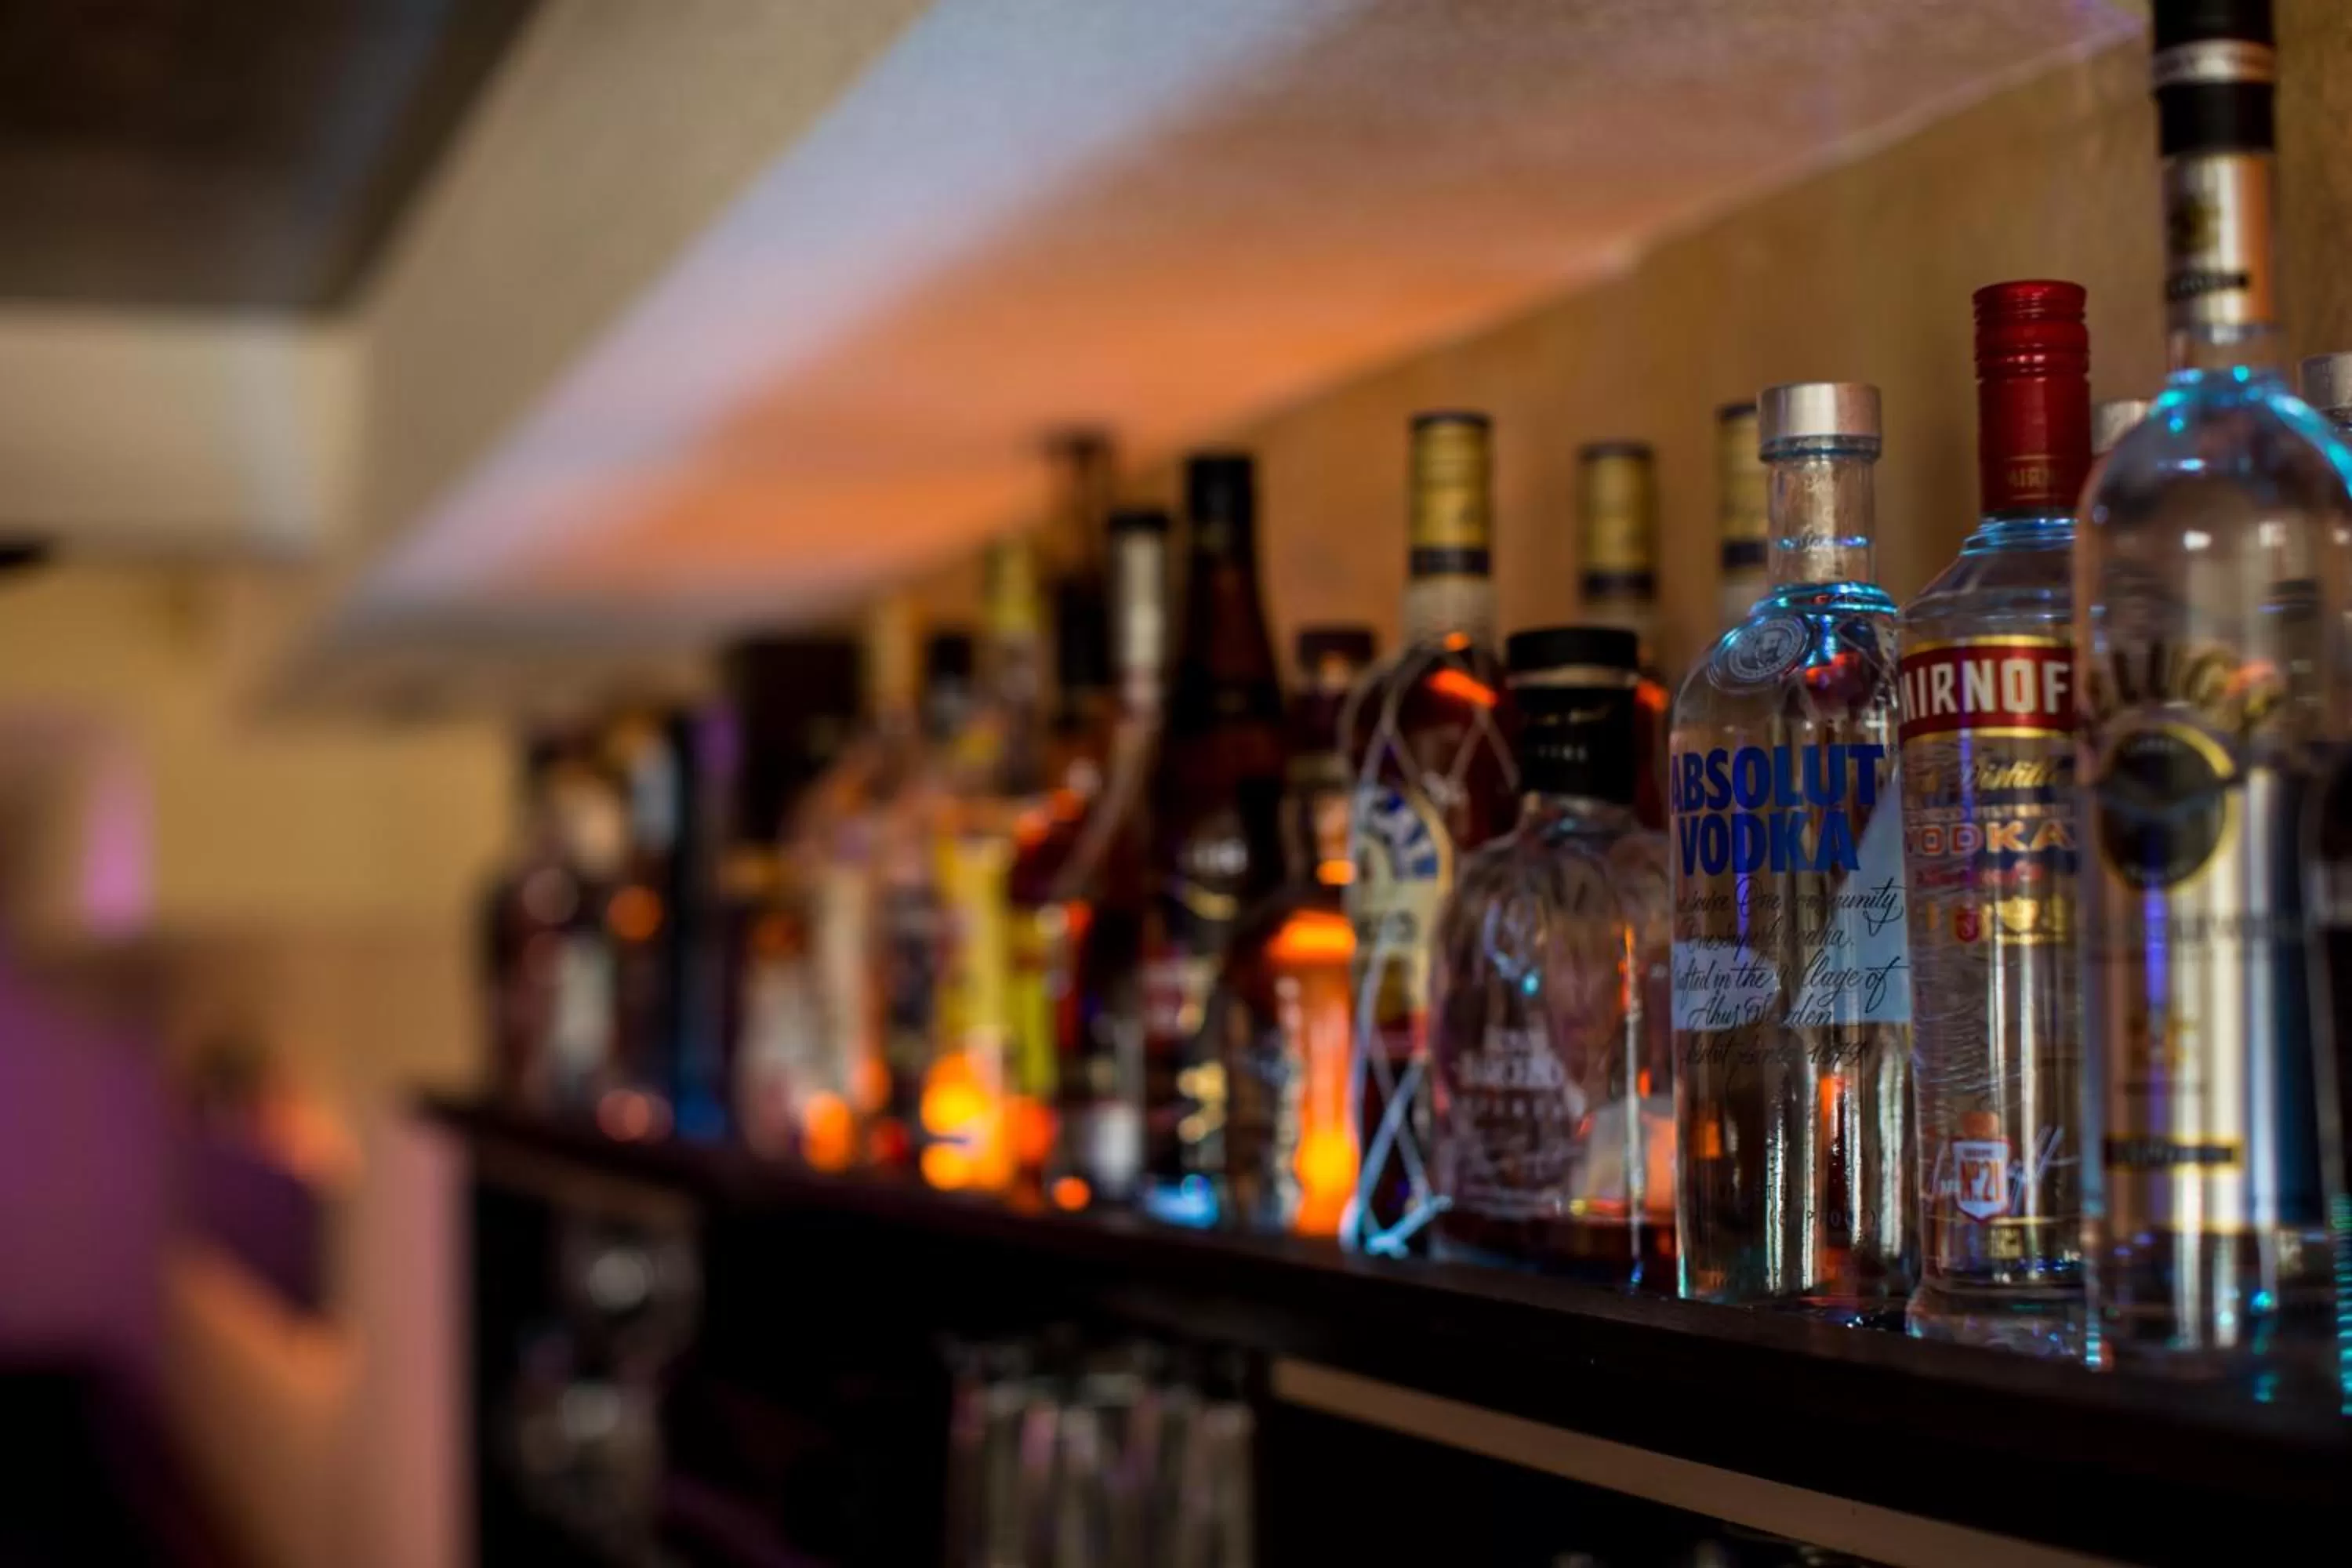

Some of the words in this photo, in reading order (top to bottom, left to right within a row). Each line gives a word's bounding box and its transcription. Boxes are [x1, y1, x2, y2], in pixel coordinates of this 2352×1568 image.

[1671, 744, 1885, 815] ABSOLUT
[1679, 809, 1860, 877] VODKA
[1730, 950, 1773, 989] the
[1779, 949, 1864, 1007] vllage
[1865, 956, 1911, 1014] of
